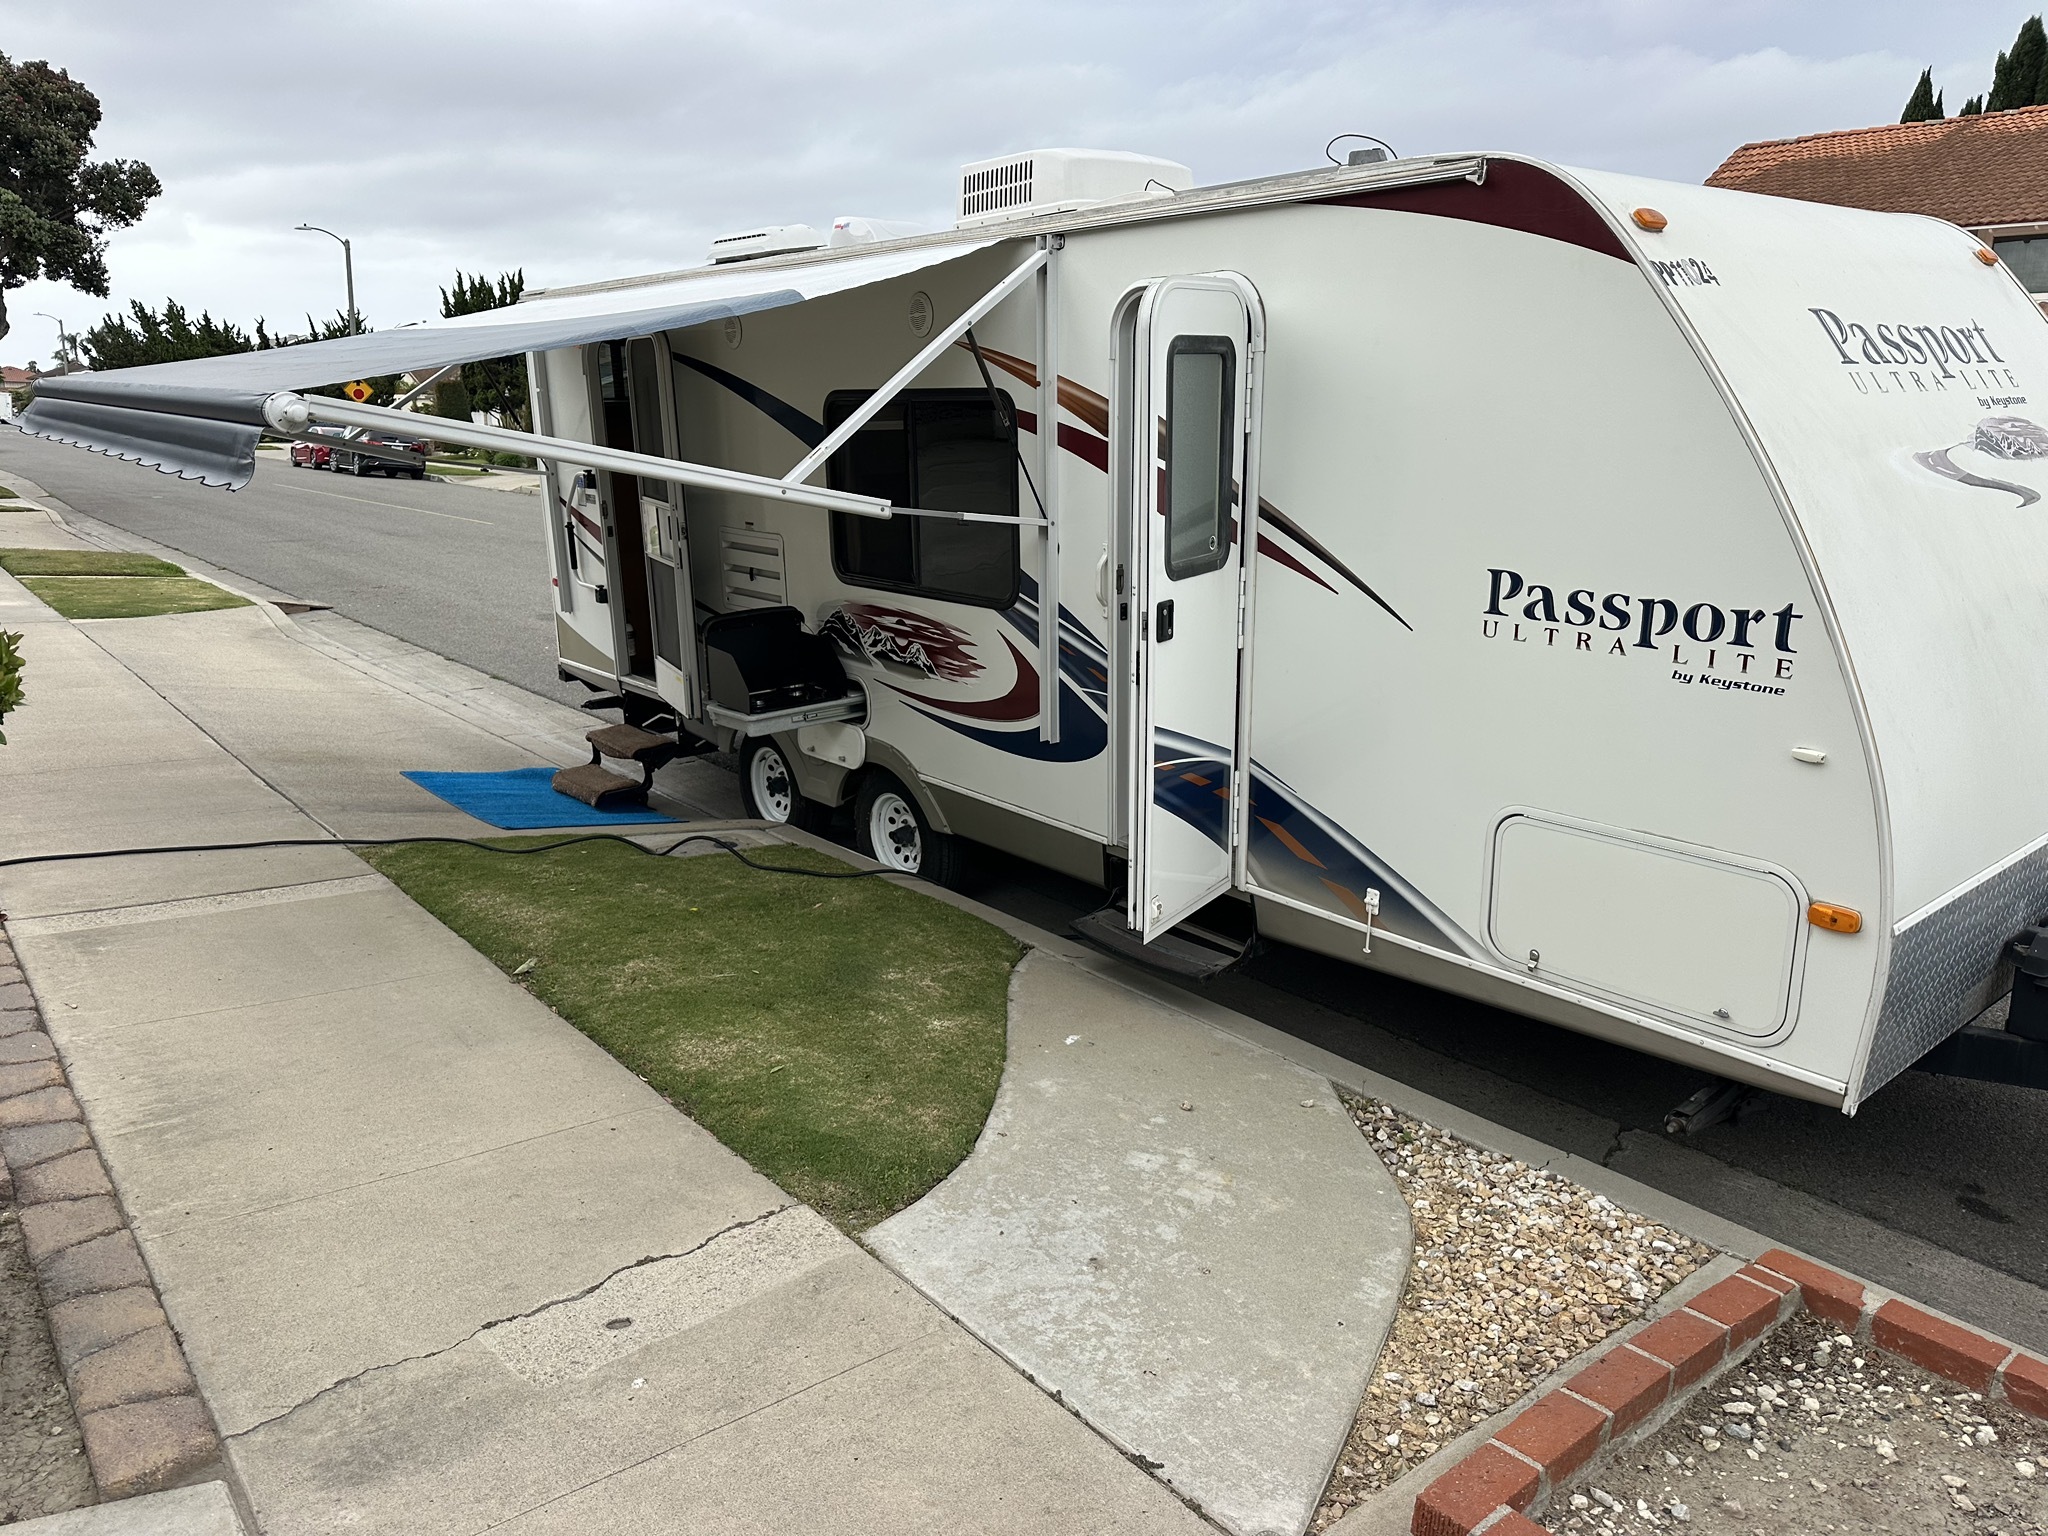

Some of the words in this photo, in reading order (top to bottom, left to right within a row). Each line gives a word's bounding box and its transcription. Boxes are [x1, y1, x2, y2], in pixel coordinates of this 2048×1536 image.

[1807, 307, 2006, 379] Passport
[1848, 370, 1948, 395] ULTRA
[1959, 368, 2020, 391] LITE
[1977, 396, 1991, 409] by
[1989, 395, 2027, 408] Keystone
[1482, 567, 1804, 654] Passport
[1482, 619, 1627, 657] ULTRA
[1671, 644, 1794, 680] LITE
[1671, 669, 1694, 685] by
[1698, 673, 1786, 697] Keystone
